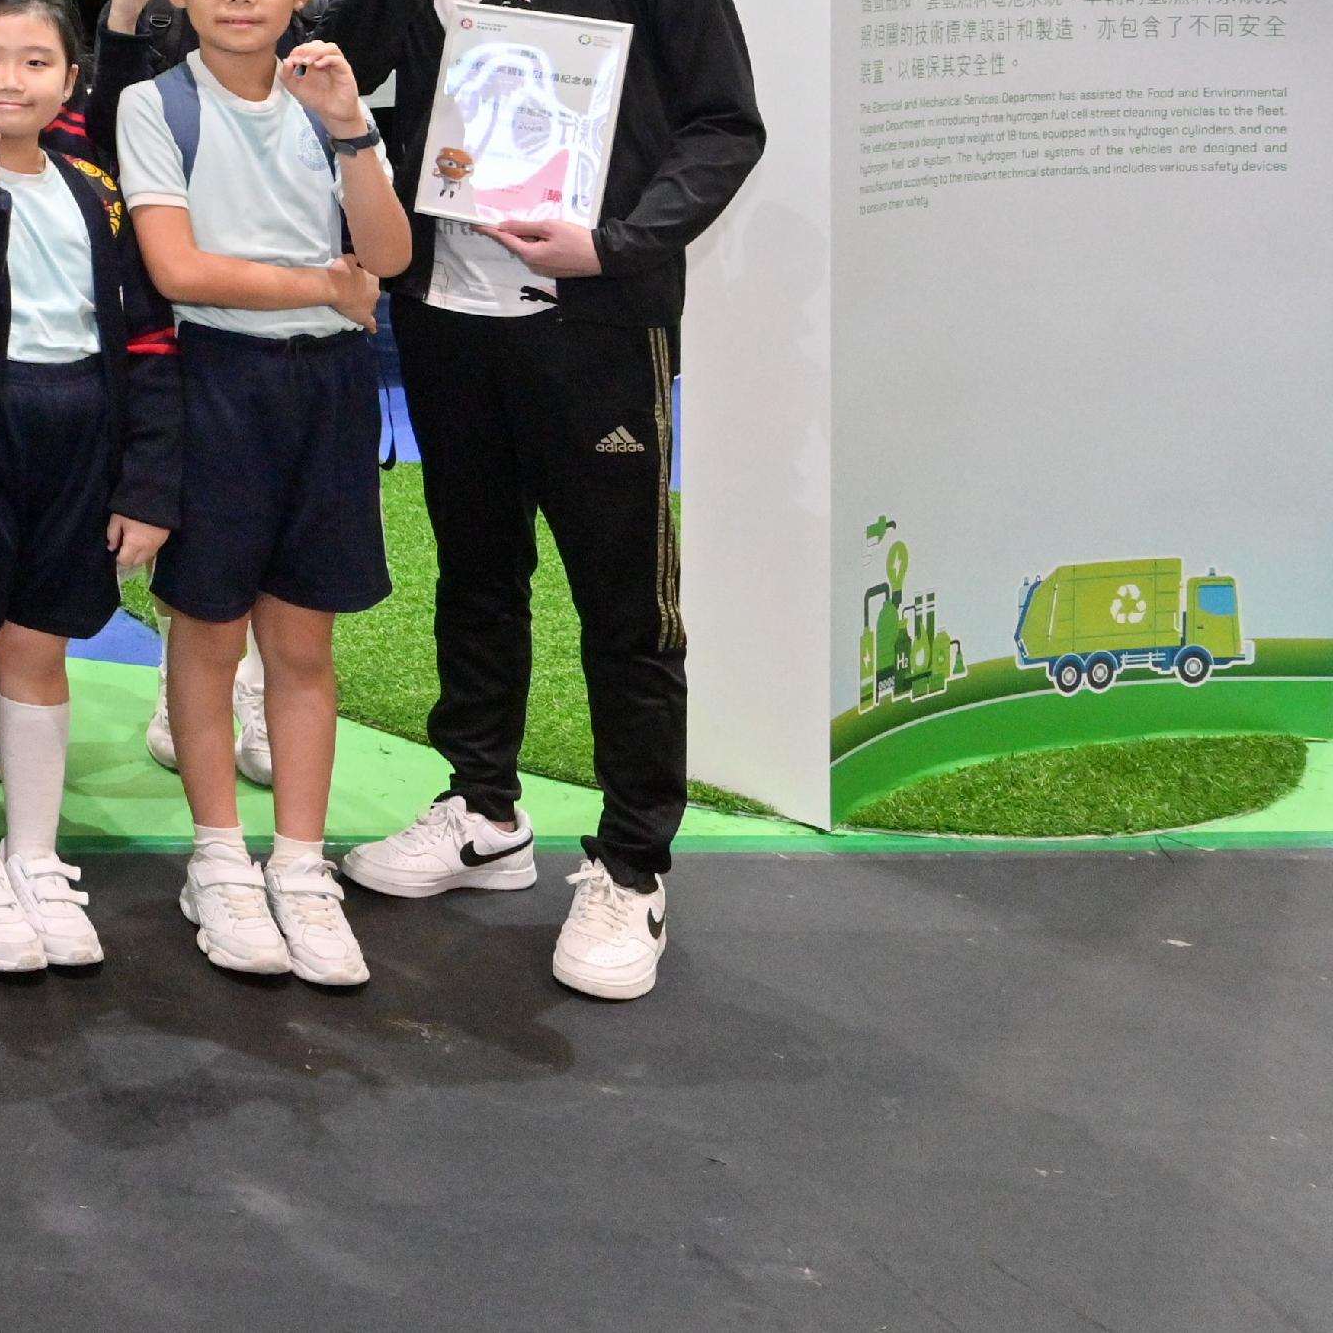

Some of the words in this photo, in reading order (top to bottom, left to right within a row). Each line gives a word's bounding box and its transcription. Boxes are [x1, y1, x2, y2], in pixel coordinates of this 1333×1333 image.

[964, 93, 998, 106] Services
[1002, 91, 1055, 104] Department
[1059, 90, 1076, 101] has
[1080, 89, 1122, 100] assisted
[1126, 88, 1143, 99] the
[1147, 87, 1174, 99] Food
[1178, 87, 1199, 98] and
[1203, 86, 1287, 98] Environmental
[936, 115, 980, 127] introducing
[982, 113, 1004, 123] three
[1006, 110, 1049, 125] hydrogen
[1051, 109, 1069, 120] fuel
[1071, 108, 1088, 119] cell
[1090, 108, 1121, 119] street
[1123, 107, 1167, 120] cleaning
[1171, 106, 1215, 117] vehicles
[1218, 106, 1230, 116] to
[1234, 105, 1253, 116] the
[1257, 105, 1288, 116] fleet.
[948, 134, 966, 145] total
[967, 133, 995, 146] weight
[997, 131, 1005, 142] of
[1042, 128, 1086, 142] equipped
[1088, 127, 1109, 138] with
[1112, 126, 1126, 137] six
[1129, 125, 1179, 139] hydrogen
[1239, 124, 1262, 135] and
[1264, 125, 1287, 135] one
[956, 152, 972, 163] The
[976, 150, 1017, 165] hydrogen
[1021, 148, 1039, 159] fuel
[1044, 147, 1085, 160] systems
[1090, 145, 1101, 156] of
[1106, 145, 1124, 156] the
[1129, 143, 1172, 155] vehicles
[1179, 144, 1197, 154] are
[1203, 142, 1258, 156] designed
[1264, 142, 1287, 153] and
[939, 174, 948, 185] to
[949, 172, 963, 184] the
[964, 170, 997, 182] relevant
[998, 167, 1039, 179] technical
[1092, 164, 1111, 175] and
[1113, 162, 1156, 174] includes
[1159, 162, 1198, 173] various
[1201, 160, 1239, 175] safety
[1241, 160, 1287, 172] devices
[595, 441, 646, 454] adidas
[896, 651, 909, 671] H2
